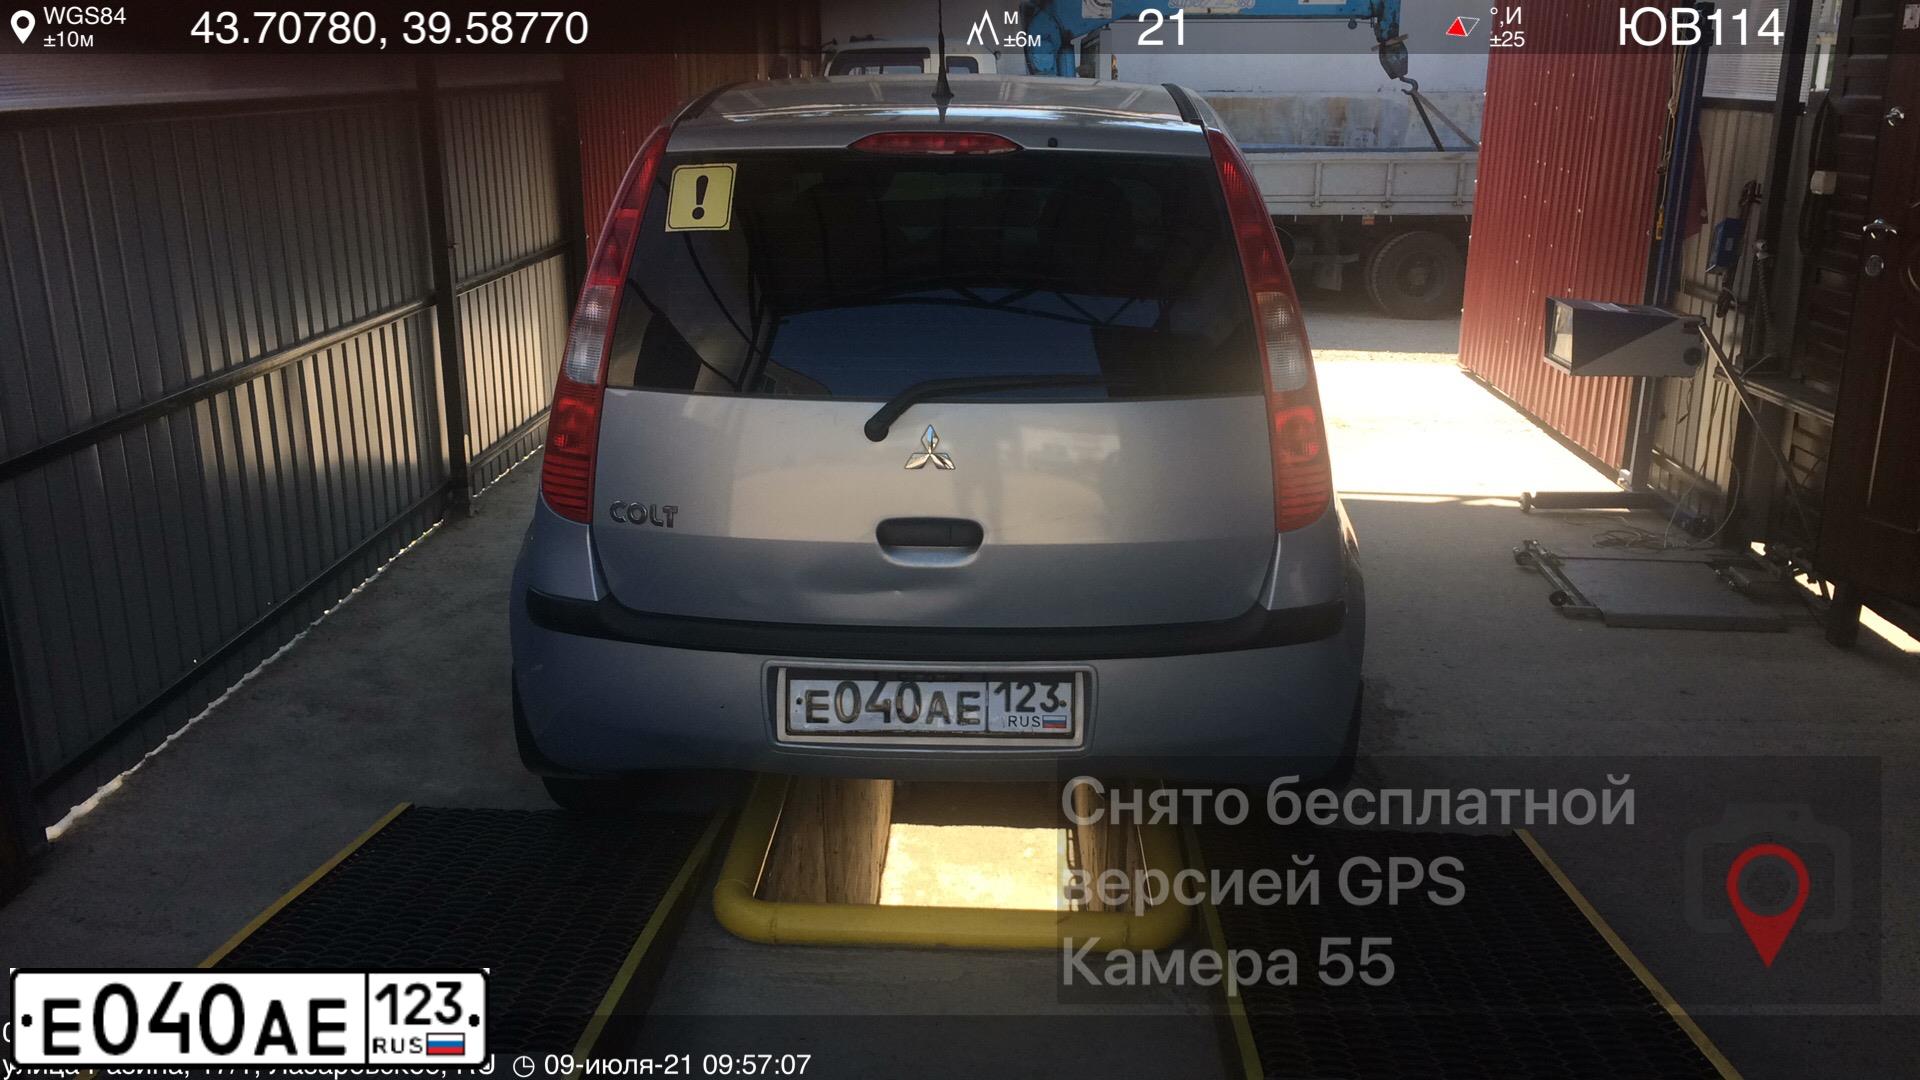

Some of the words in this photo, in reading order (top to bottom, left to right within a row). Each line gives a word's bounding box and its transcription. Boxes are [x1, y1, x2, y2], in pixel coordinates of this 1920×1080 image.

[609, 500, 679, 528] COLT
[993, 681, 1059, 713] 123
[1008, 714, 1041, 728] RUS
